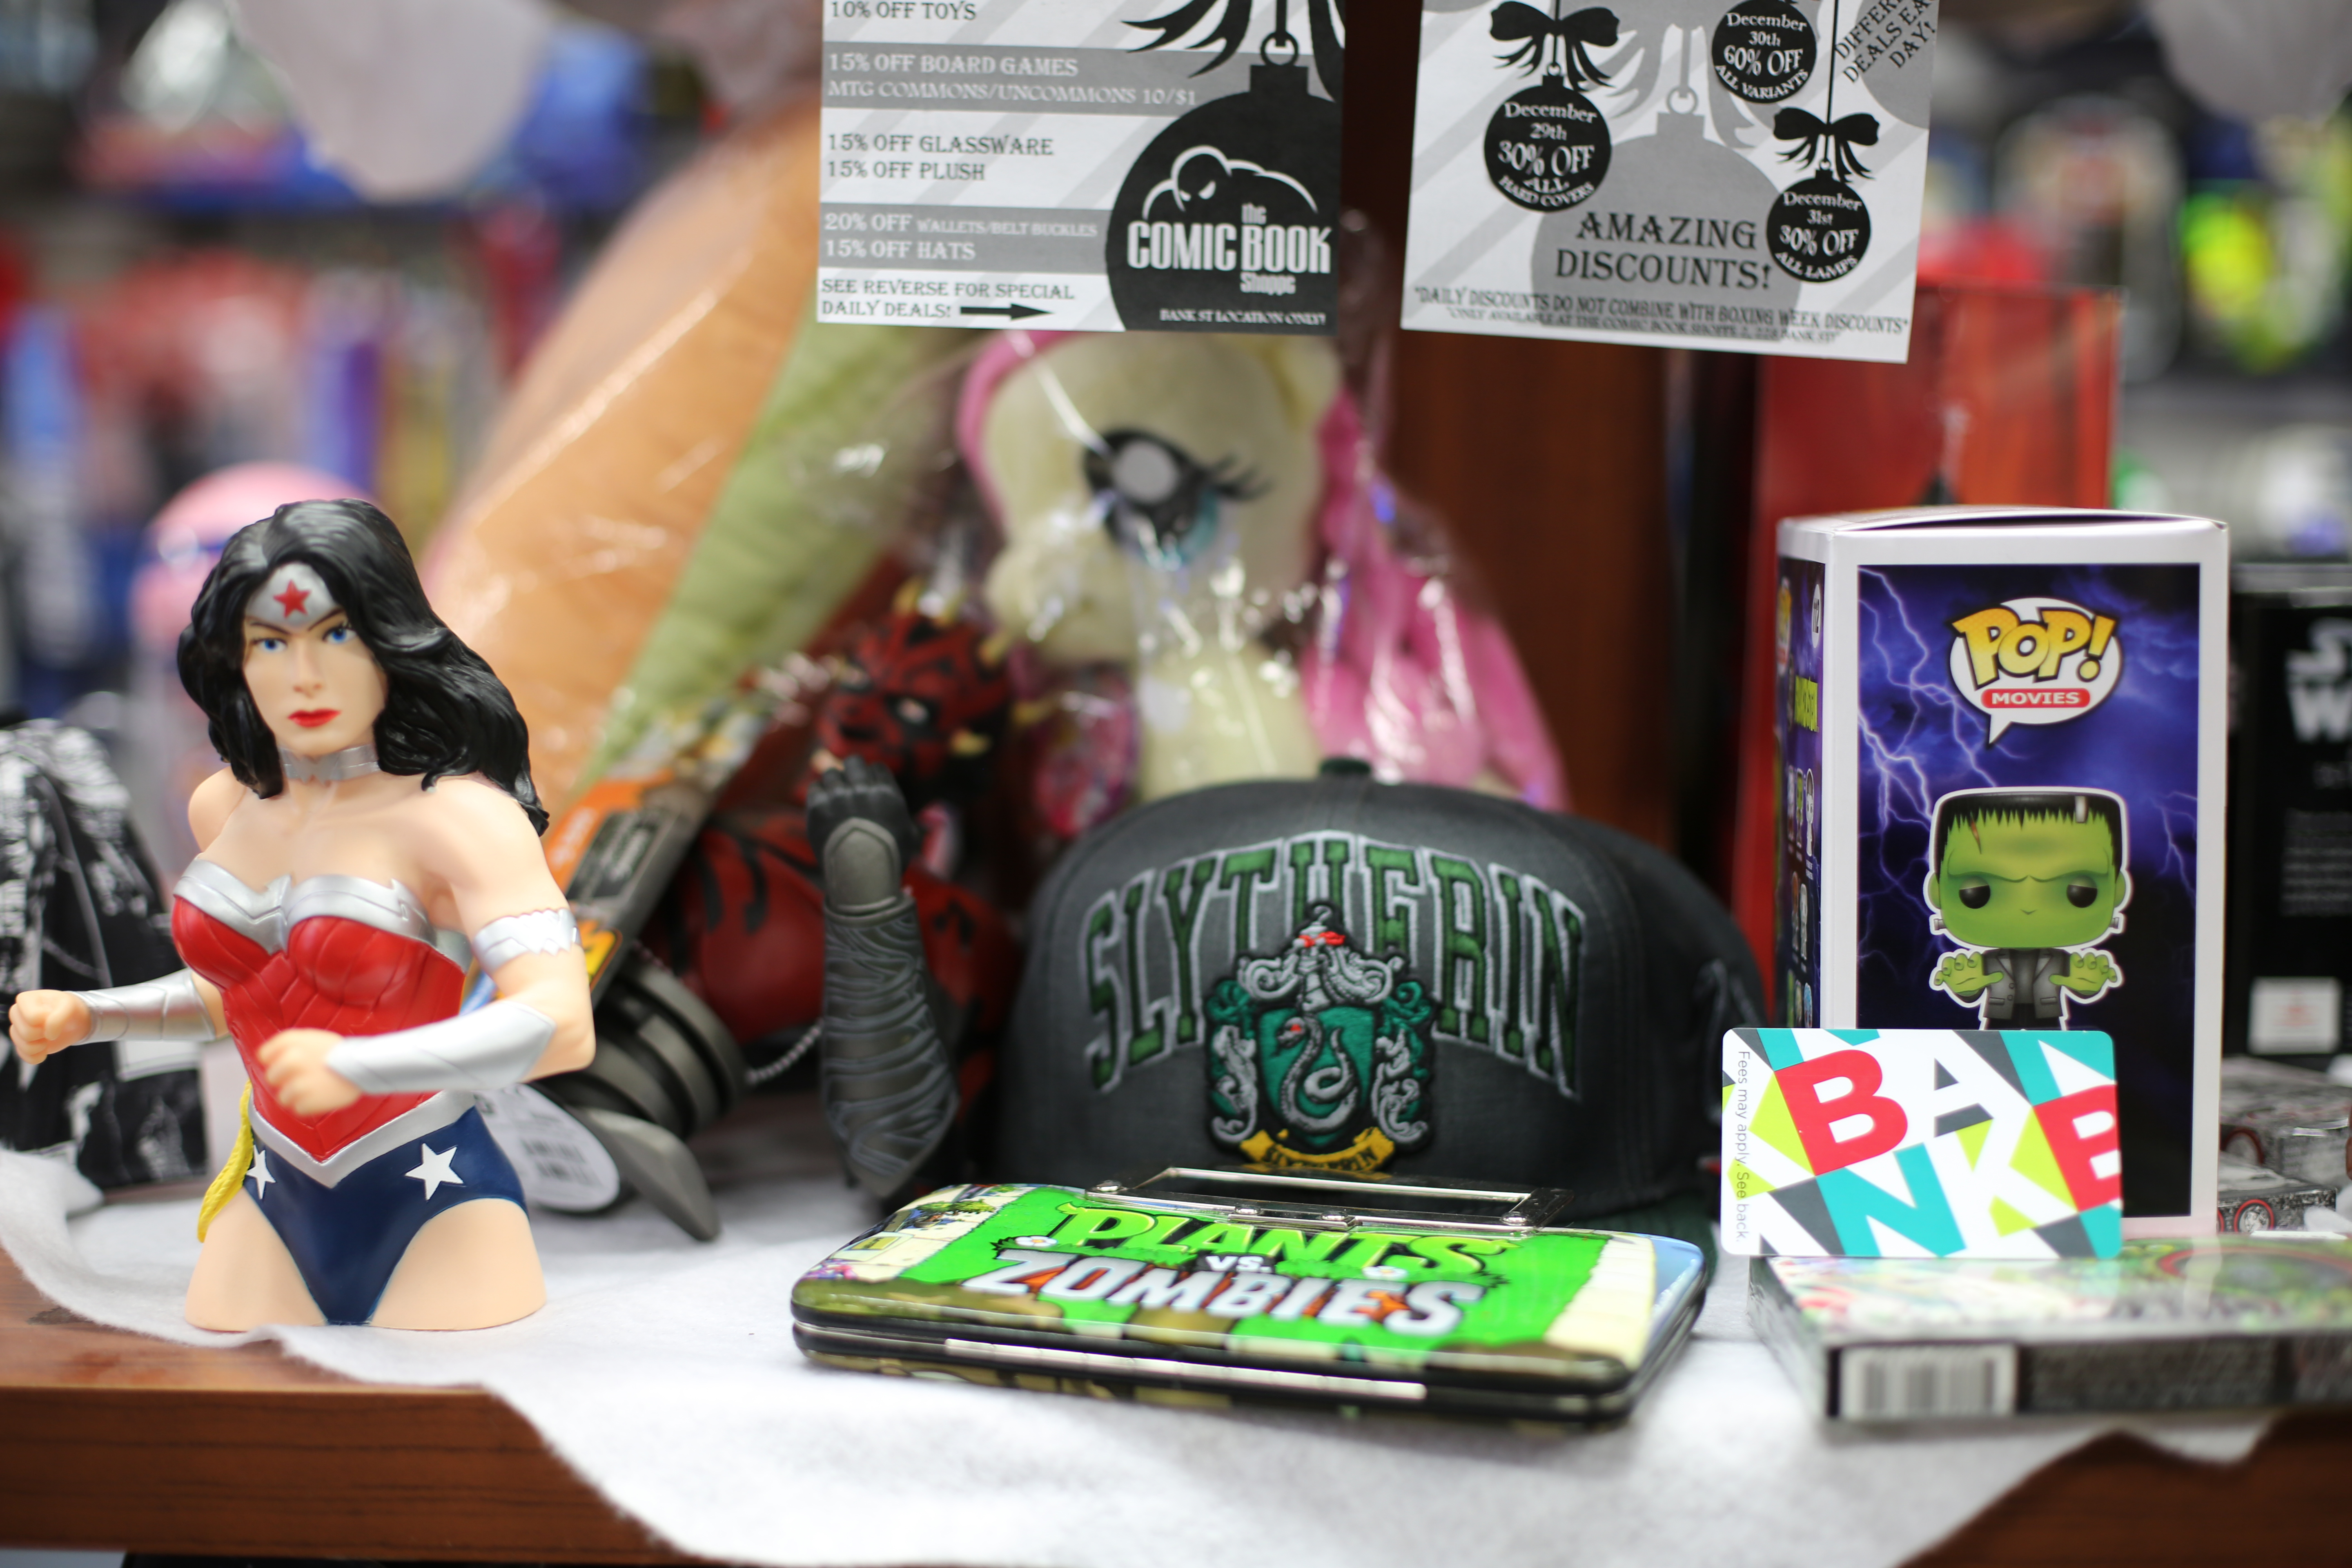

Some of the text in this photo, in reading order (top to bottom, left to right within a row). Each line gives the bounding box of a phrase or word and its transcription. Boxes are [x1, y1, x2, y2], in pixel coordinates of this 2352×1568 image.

[832, 1, 977, 20] 10% OFF TOYS
[1726, 12, 1807, 32] December
[1748, 31, 1781, 47] 30th
[1889, 20, 1936, 68] DAY!
[1724, 45, 1804, 76] 60% OFF
[1842, 21, 1902, 83] DEALS
[829, 53, 1079, 76] 15% OFF BOARD GAMES
[828, 81, 874, 97] MTG
[1715, 65, 1809, 100] ALL VARIANTS
[1504, 102, 1598, 123] December
[1530, 122, 1567, 140] 29th
[829, 134, 1054, 156] 15% OFF GLASSWARE
[1498, 140, 1595, 176] 30% OFF
[828, 161, 986, 180] 15% OFF PLUSH
[1523, 177, 1570, 194] ALL
[1783, 191, 1863, 212] December
[824, 213, 867, 232] 20%
[871, 214, 913, 232] OFF
[1031, 223, 1098, 237] BUCKLES
[1806, 209, 1833, 226] 31st
[1576, 212, 1757, 250] AMAZING
[1779, 225, 1859, 256] 30% OFF
[826, 239, 976, 260] 15% OFF HATS
[1127, 221, 1332, 273] COMIC BOOK
[1556, 248, 1771, 290] DISCOUNTS!
[1775, 252, 1858, 279] ALL LAMPS
[822, 279, 1075, 300] SEE REVERSE FOR SPECIAL
[822, 300, 951, 318] DAILY DEALS!
[1470, 289, 1550, 311] DISCOUNTS
[1553, 295, 1573, 312] DO
[1576, 296, 1606, 314] NOT
[1608, 298, 1675, 318] COMBINE
[1679, 300, 1715, 321] WITH
[1719, 305, 1774, 325] BOXING
[1778, 307, 1821, 329] WEEK
[1991, 692, 2080, 706] MOVIES
[1735, 1051, 1751, 1243] Fees may apply. See back.
[1056, 1201, 1522, 1273] PLANTS
[960, 1248, 1486, 1337] ZOMBIES
